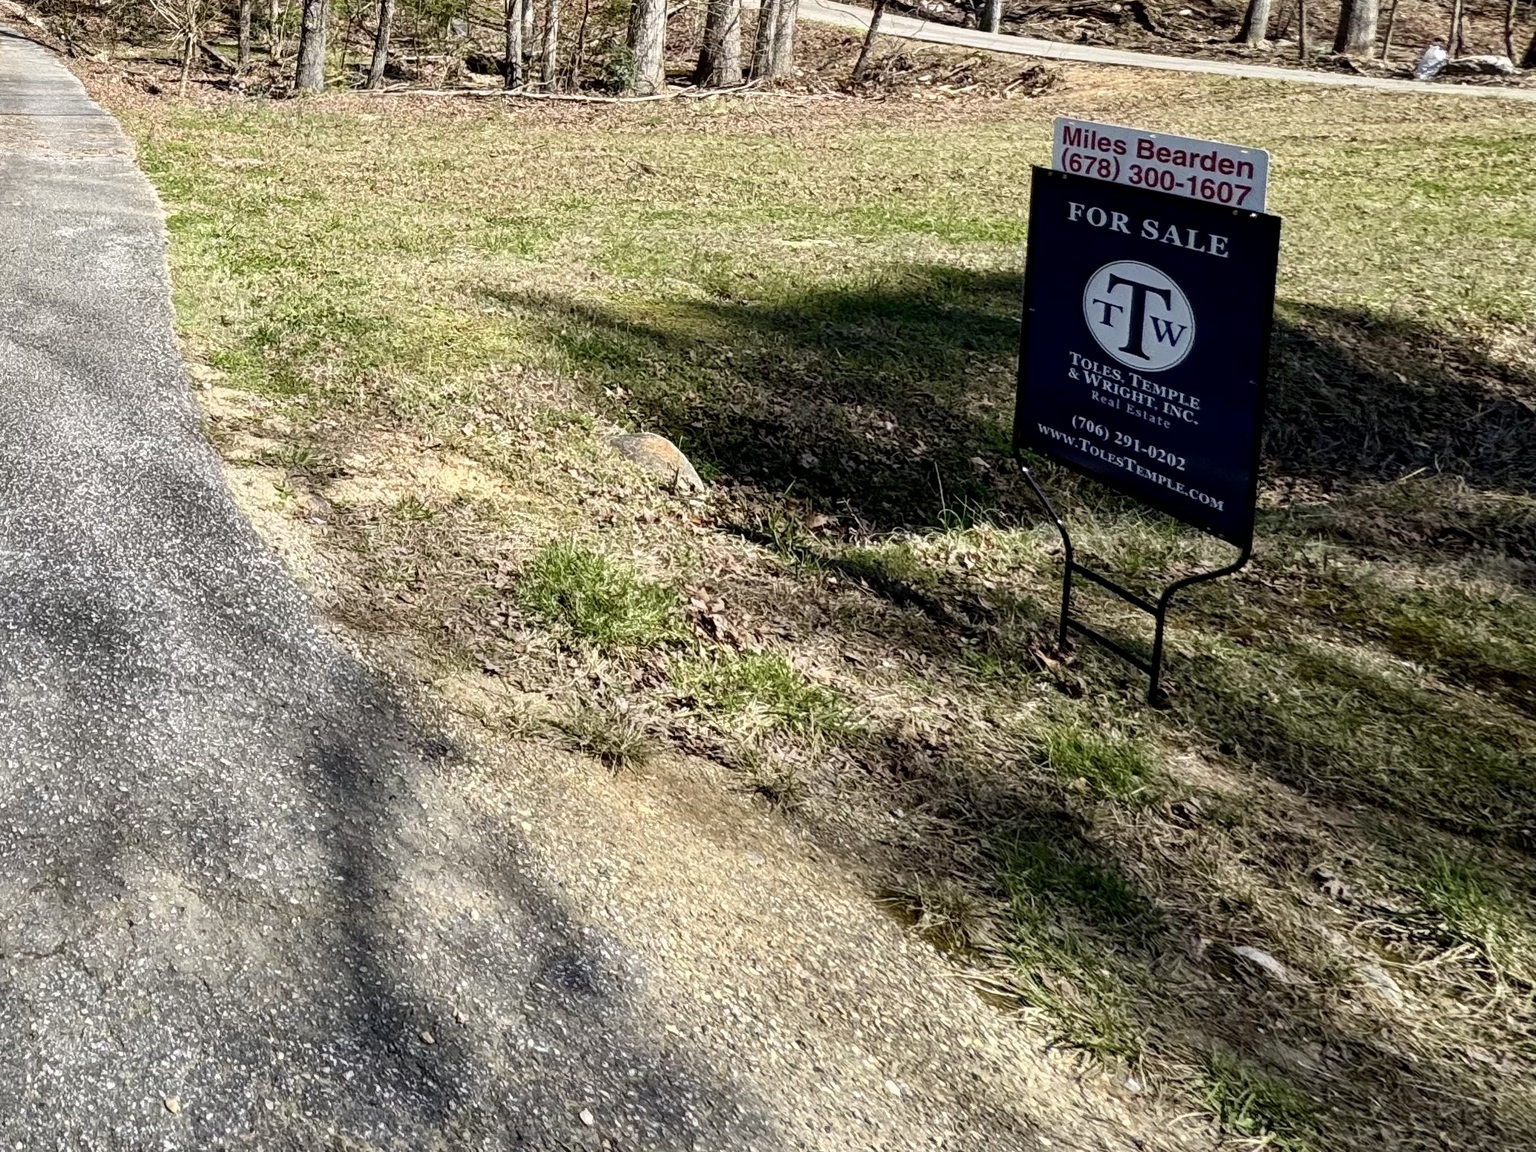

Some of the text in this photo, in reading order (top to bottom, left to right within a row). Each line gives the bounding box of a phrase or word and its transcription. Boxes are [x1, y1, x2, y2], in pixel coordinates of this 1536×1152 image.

[1061, 147, 1253, 207] (678) 300-1607
[1062, 125, 1254, 180] Miles Bearden
[1067, 201, 1229, 259] FOR SALE
[1067, 367, 1080, 381] &
[1162, 401, 1199, 426] INC.
[1091, 389, 1171, 429] Real Estate
[1128, 371, 1201, 411] TEMPLE
[1071, 414, 1187, 471] (706) 291-0202
